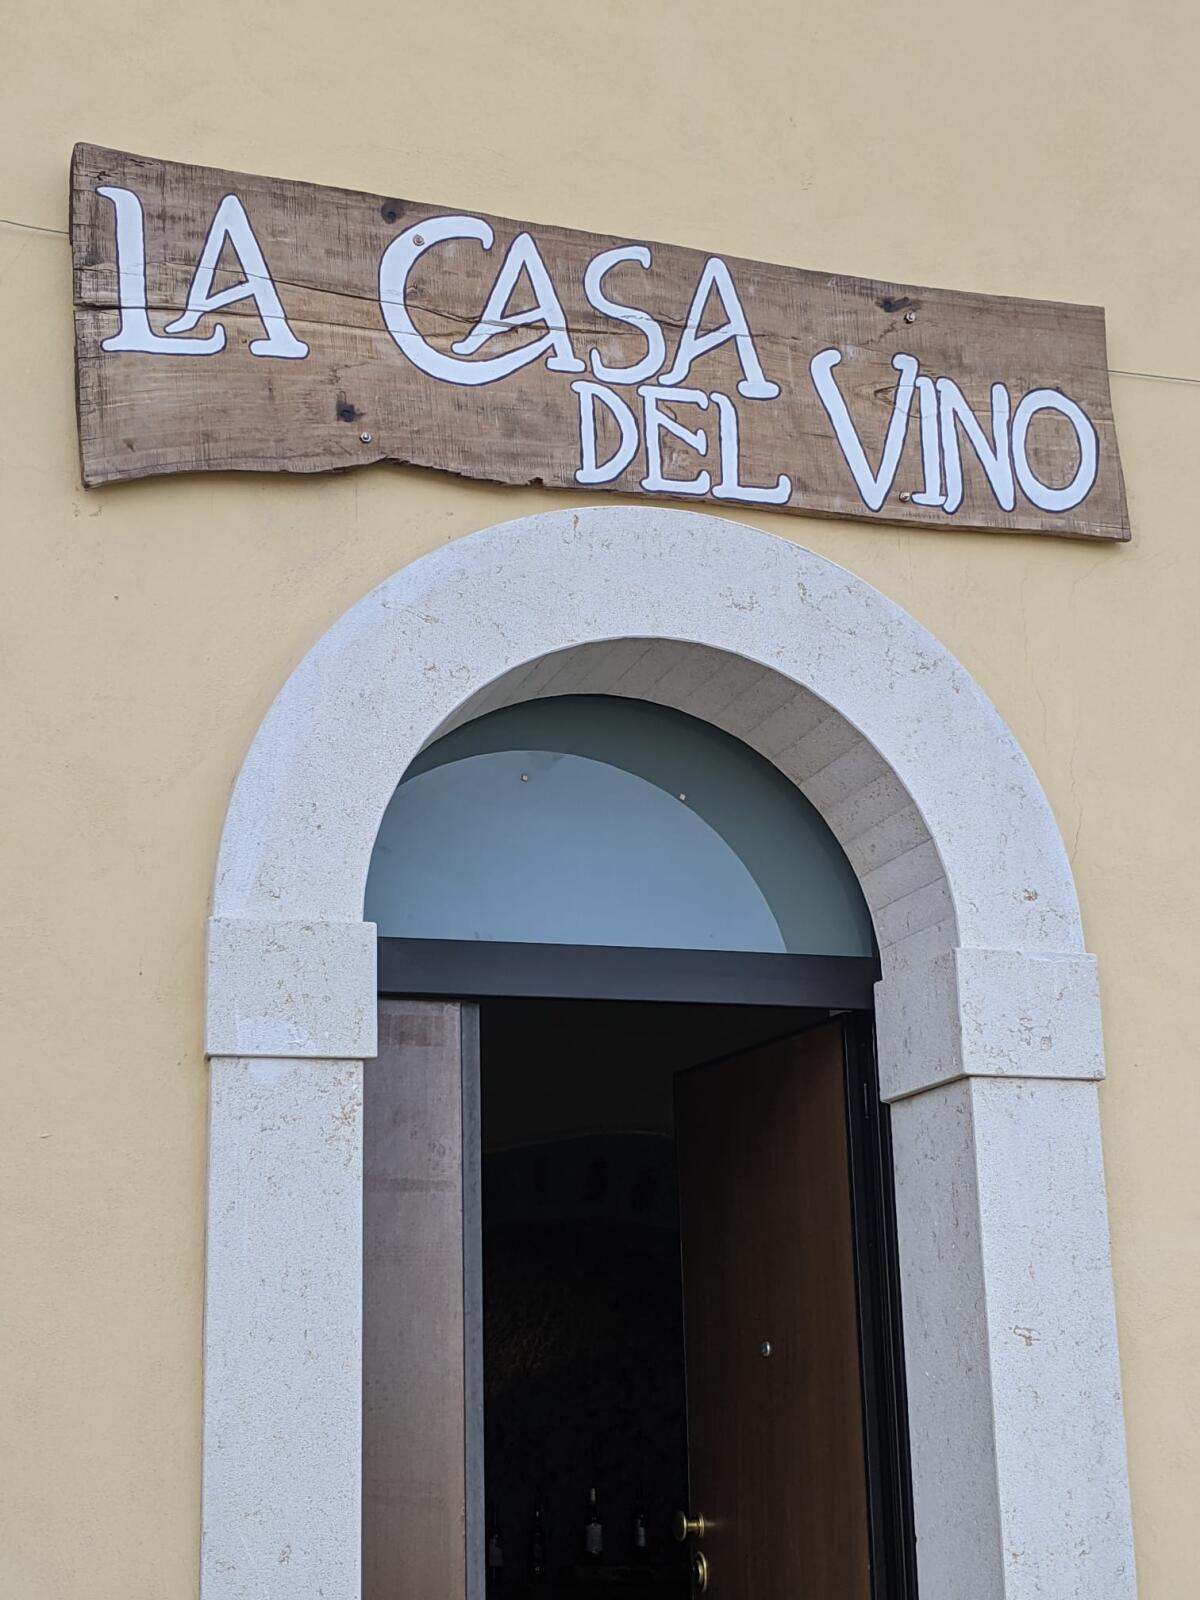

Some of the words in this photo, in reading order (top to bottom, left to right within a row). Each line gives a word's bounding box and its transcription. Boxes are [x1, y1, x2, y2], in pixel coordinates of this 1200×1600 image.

[96, 186, 309, 359] LA
[378, 214, 781, 400] CASA
[571, 379, 792, 505] DEL
[810, 346, 1099, 513] VINO
